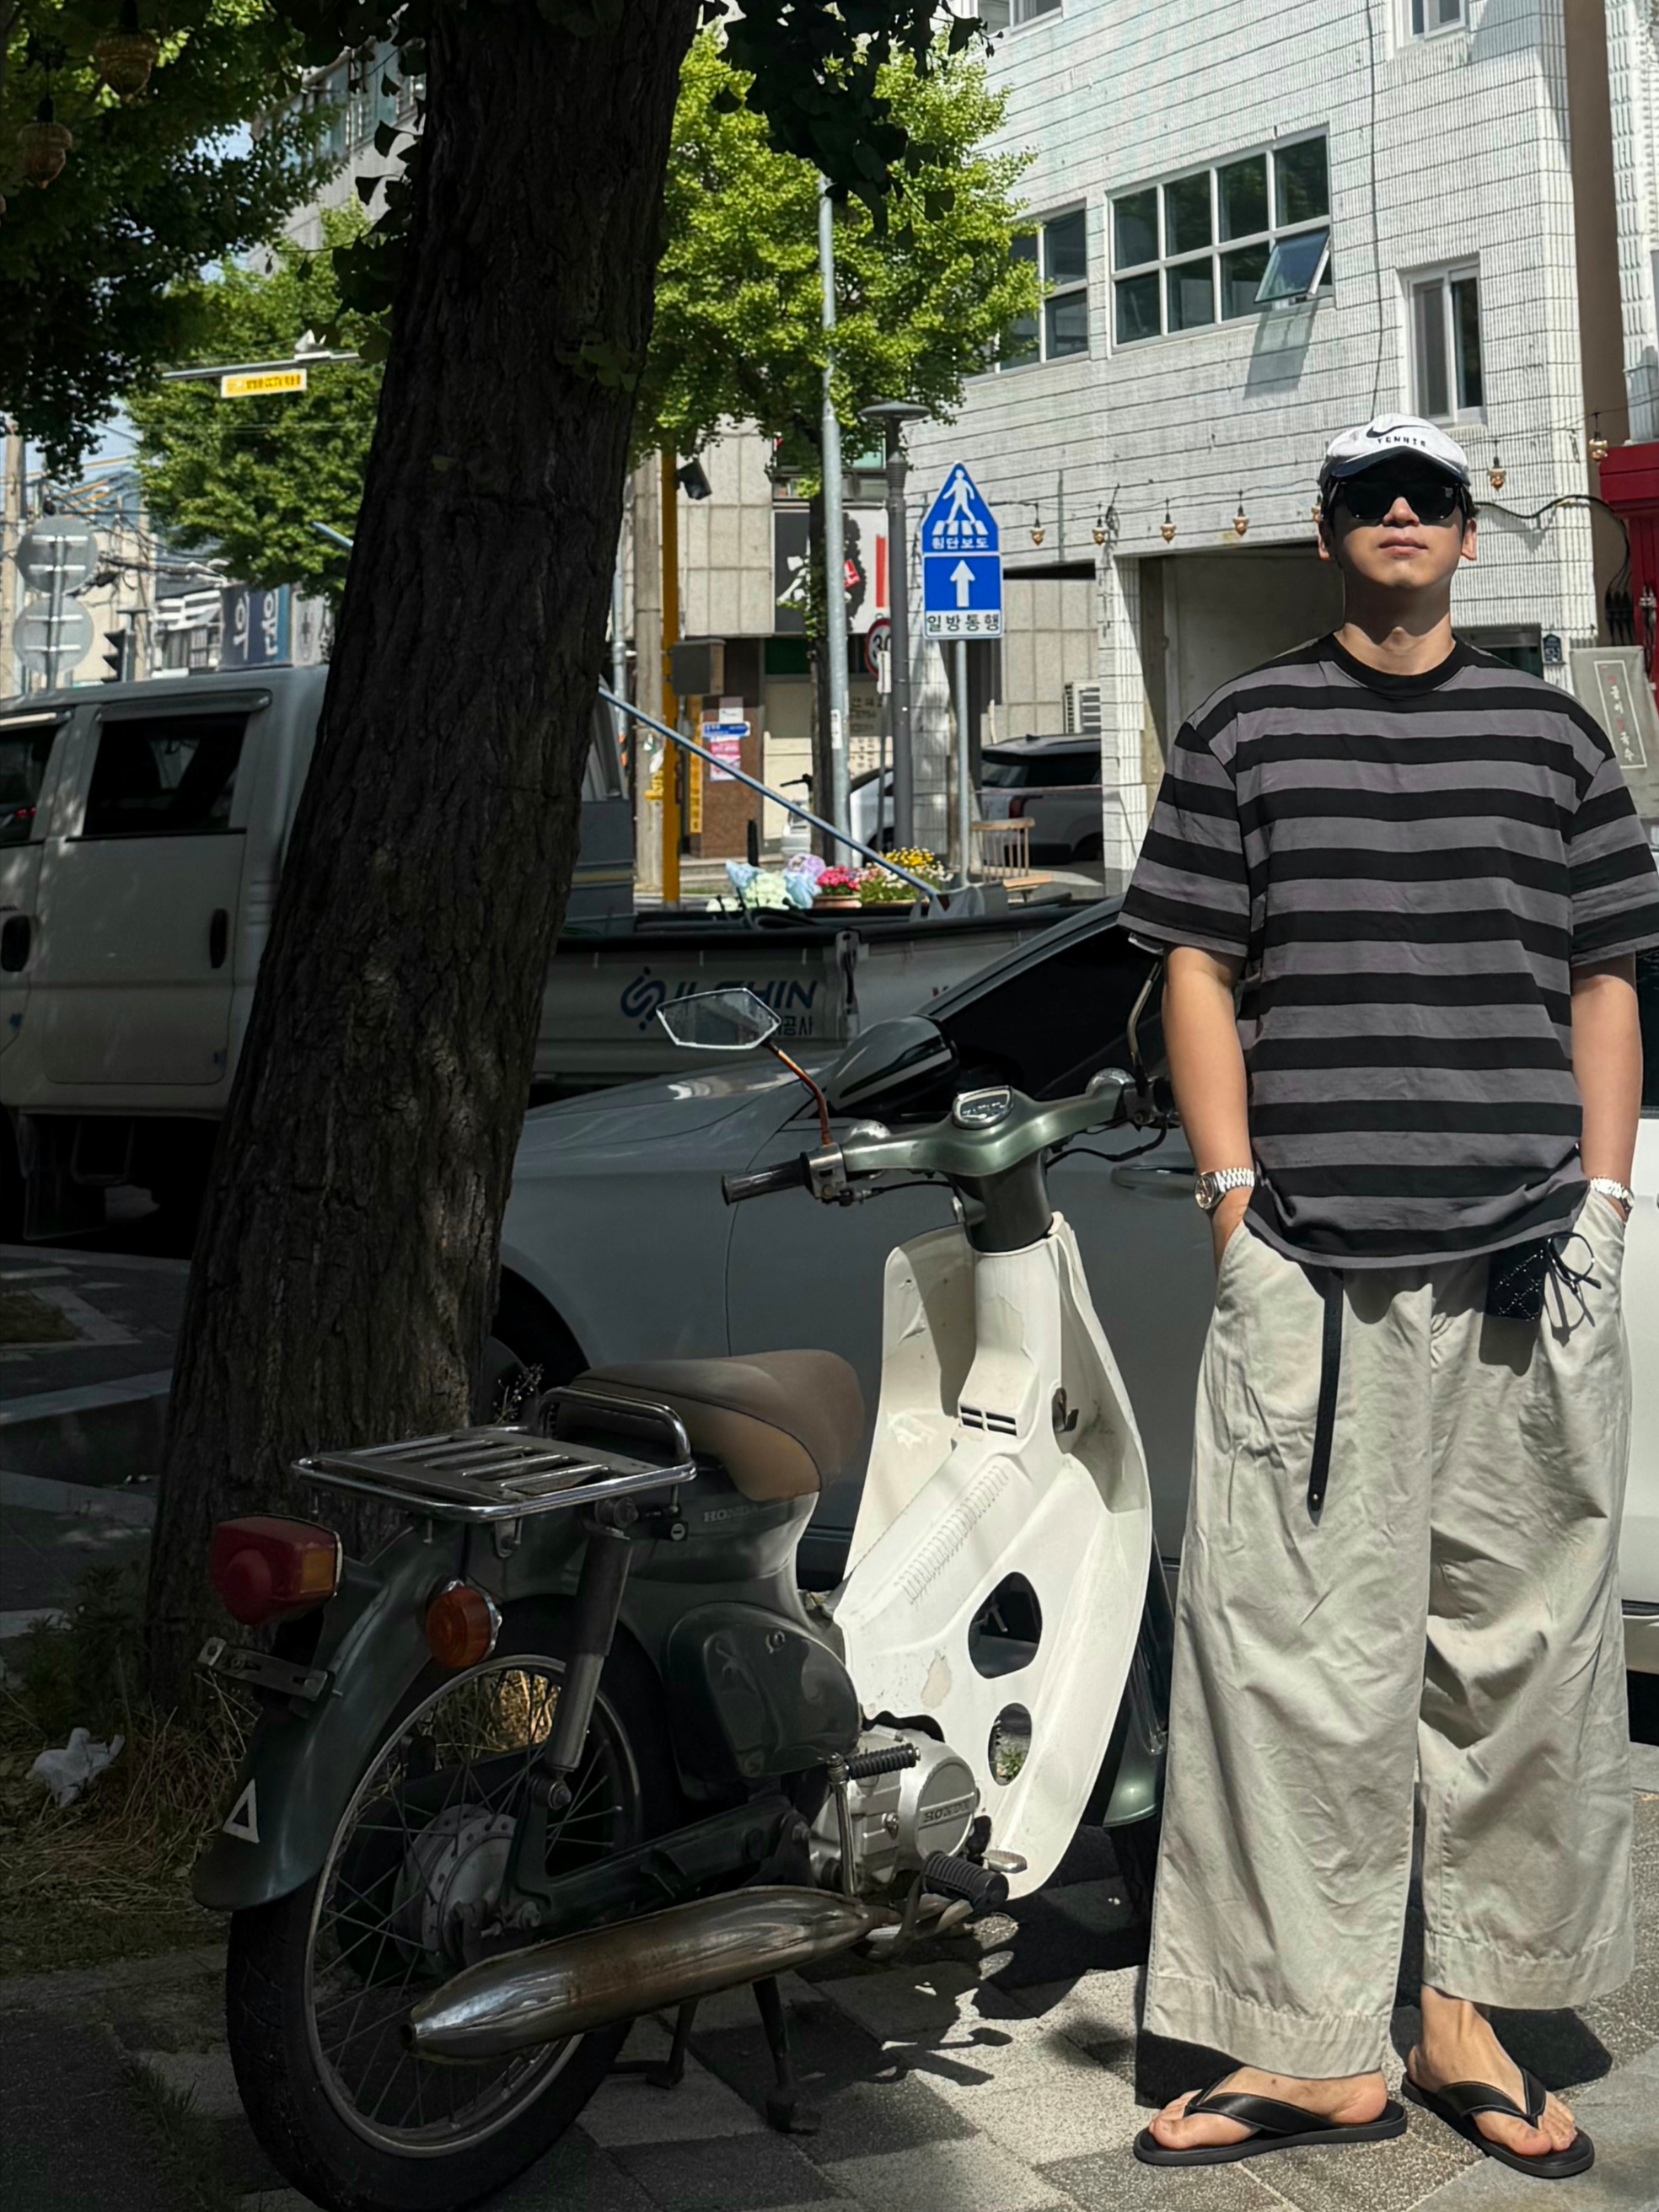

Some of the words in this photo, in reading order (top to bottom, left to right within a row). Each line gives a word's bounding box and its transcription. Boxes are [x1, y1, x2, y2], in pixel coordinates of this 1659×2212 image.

[1377, 435, 1426, 448] TENNIS
[932, 536, 989, 550] 횡단보도
[927, 614, 1000, 632] 일방통행
[676, 980, 818, 1009] IHIN
[923, 1798, 971, 1823] HONDA
